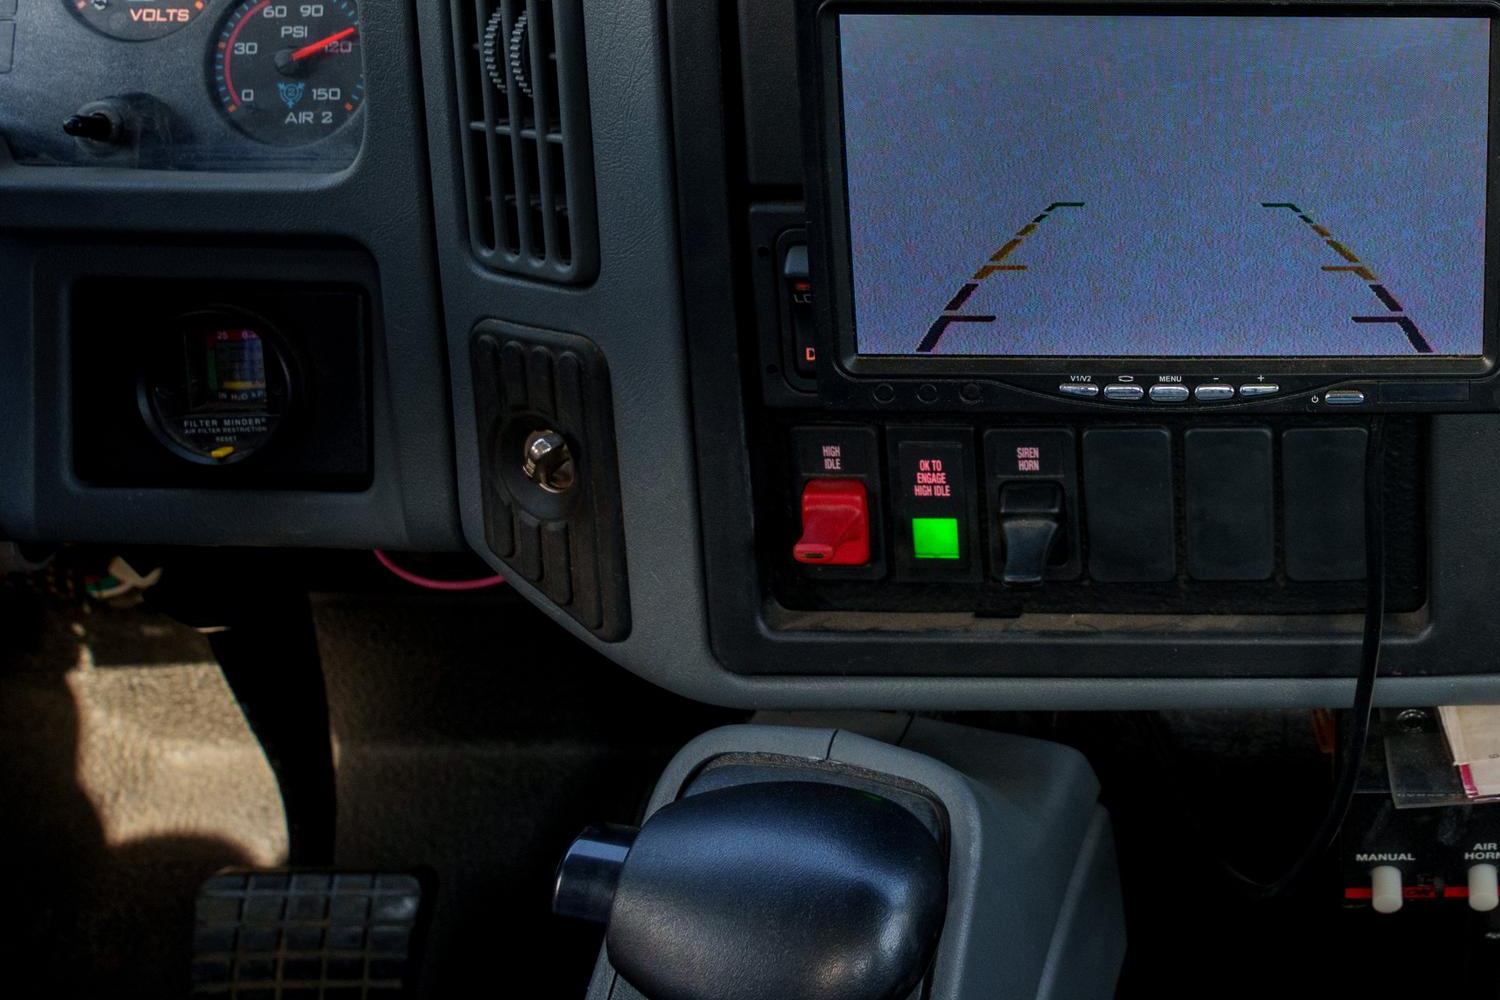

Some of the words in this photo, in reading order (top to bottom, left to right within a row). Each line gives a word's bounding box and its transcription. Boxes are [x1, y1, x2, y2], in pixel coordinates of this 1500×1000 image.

[130, 8, 190, 22] VOLTS
[263, 5, 287, 18] 60
[300, 4, 324, 17] 90
[281, 26, 308, 38] PSI
[234, 42, 258, 55] 30
[241, 89, 254, 101] 0
[312, 88, 341, 101] 150
[284, 112, 314, 124] AIR
[321, 112, 333, 124] 2
[184, 419, 218, 428] FILTER
[222, 425, 268, 433] RESTRICTION
[822, 446, 841, 457] HIGH
[1016, 447, 1040, 459] SIREN
[824, 458, 841, 470] IDLE
[919, 460, 930, 472] OK
[931, 460, 942, 472] TO
[1018, 459, 1040, 471] HORN
[916, 473, 946, 484] ENGAGE
[914, 485, 932, 497] HIGH
[933, 485, 951, 497] IDLE
[1473, 842, 1498, 851] AIR
[1355, 853, 1416, 862] MANUAL
